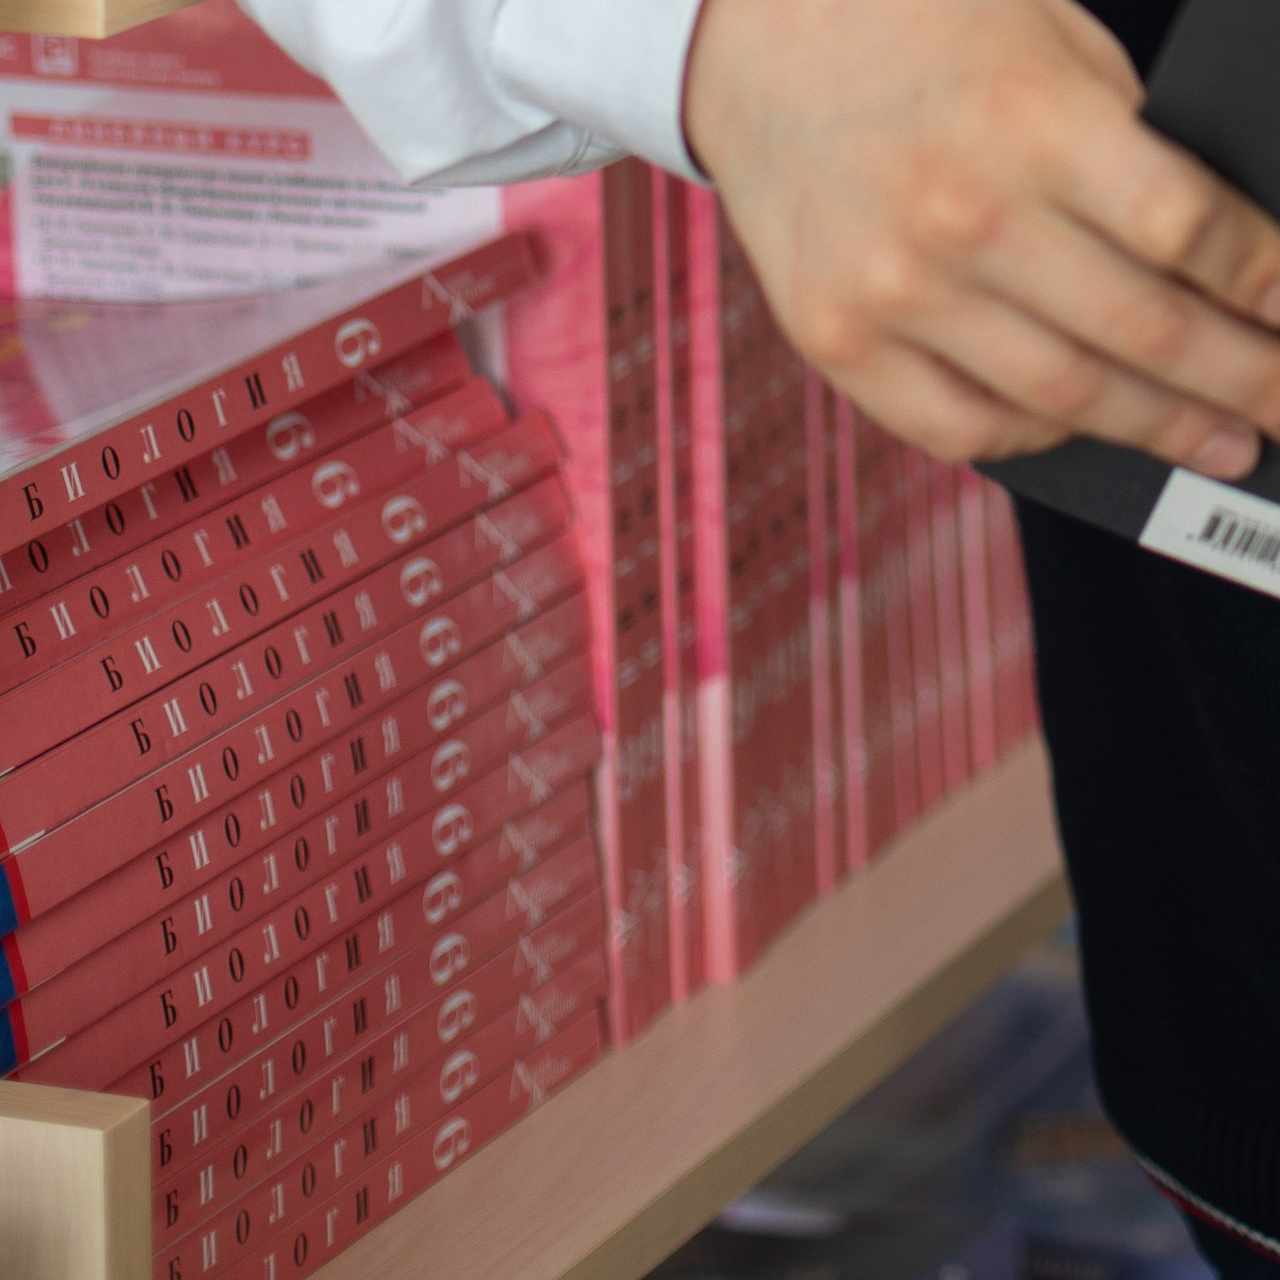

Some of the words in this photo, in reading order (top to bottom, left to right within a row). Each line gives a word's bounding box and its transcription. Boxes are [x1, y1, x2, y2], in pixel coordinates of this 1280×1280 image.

[22, 351, 306, 522] БИОЛОГИЯ
[333, 317, 381, 368] 6
[266, 412, 315, 461] 6
[13, 492, 288, 659] БИОЛОГИЯ
[311, 459, 361, 508] 6
[99, 528, 360, 693] БИОЛОГИЯ
[381, 494, 428, 544] 6
[129, 590, 379, 757] БИОЛОГИЯ
[400, 555, 444, 608] 6
[154, 650, 399, 825] БИОЛОГИЯ
[419, 614, 463, 668] 6
[154, 715, 402, 891] БИОЛОГИЯ
[426, 679, 469, 732] 6
[159, 776, 405, 957] БИОЛОГИЯ
[430, 739, 472, 793] 6
[159, 842, 407, 1030] БИОЛОГИЯ
[431, 802, 475, 857] 6
[149, 910, 396, 1102] БИОЛОГИЯ
[422, 870, 462, 925] 6
[157, 973, 402, 1169] БИОЛОГИЯ
[430, 932, 470, 986] 6
[440, 1048, 480, 1105] 6
[165, 1032, 410, 1230] БИОЛОГИЯ
[437, 989, 478, 1043] 6
[433, 1116, 471, 1170] 6
